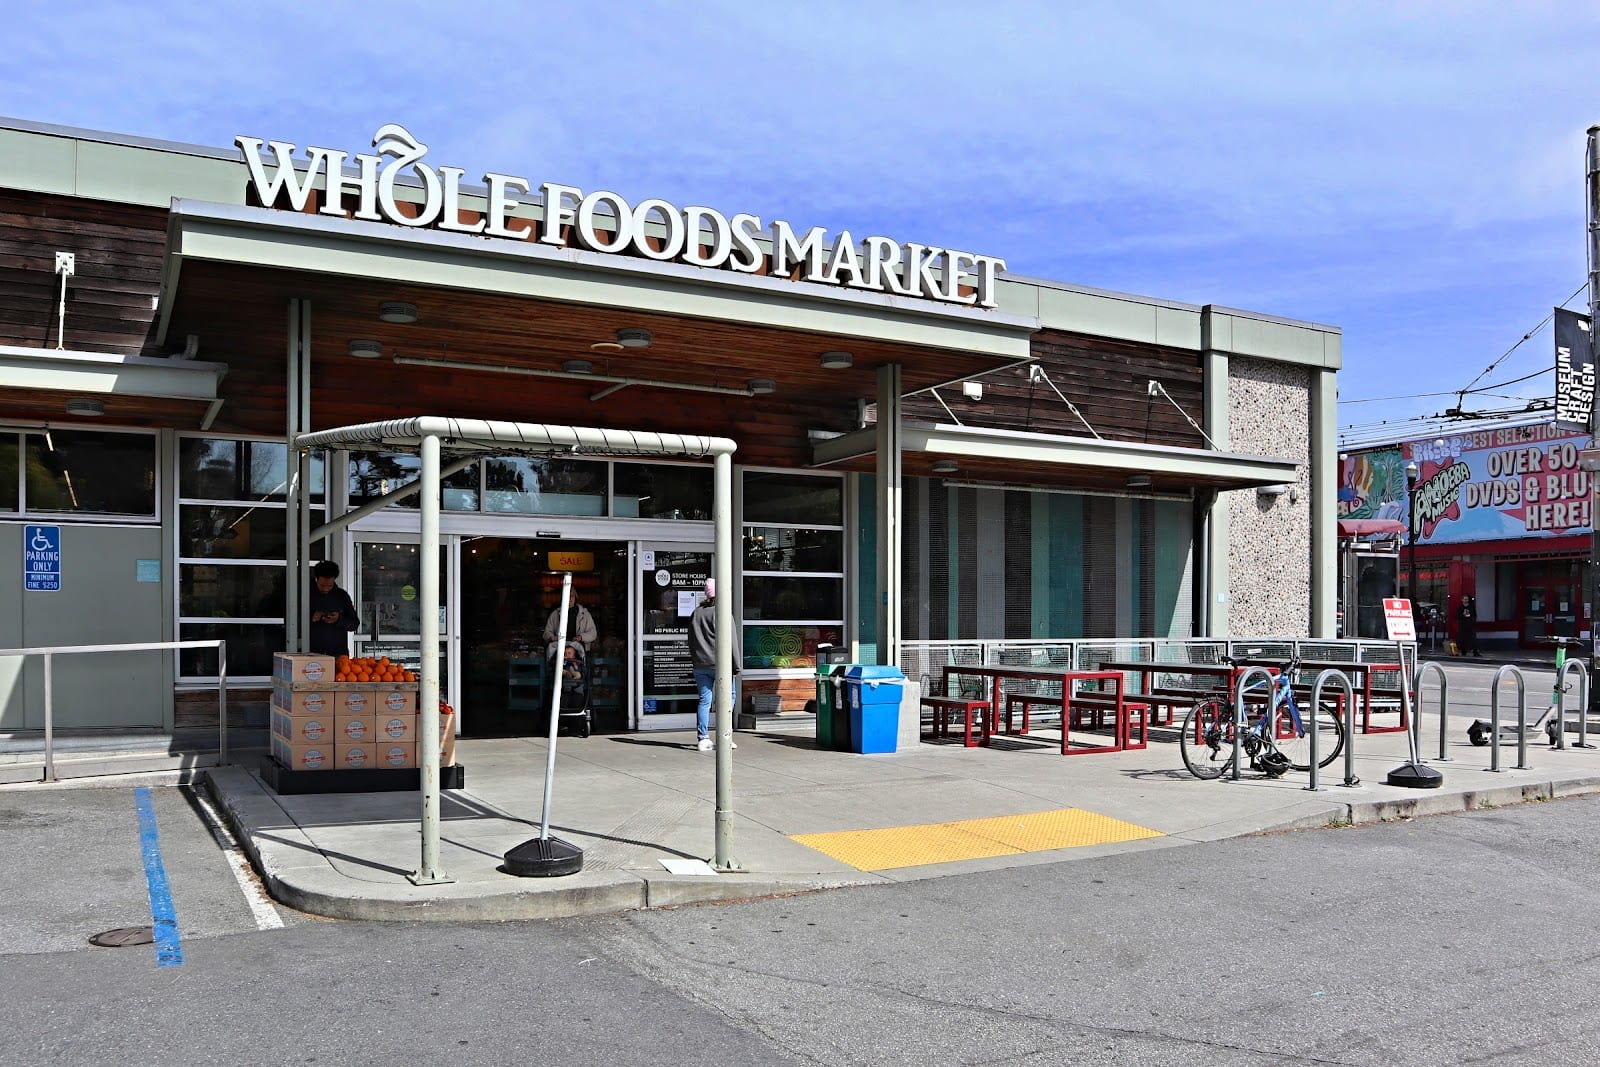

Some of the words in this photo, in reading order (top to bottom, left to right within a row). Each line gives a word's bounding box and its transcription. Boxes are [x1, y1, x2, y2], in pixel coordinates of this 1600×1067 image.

[234, 123, 532, 240] WHOLE
[540, 182, 763, 274] FOODS
[769, 219, 1008, 309] MARKET
[1557, 346, 1571, 421] MUSEUM
[1567, 367, 1583, 423] CRAFT
[1577, 363, 1595, 424] DESIGN
[1487, 446, 1544, 478] OVER
[1413, 461, 1471, 535] AMOEBA
[1431, 486, 1460, 523] MUSIC
[1466, 478, 1521, 509] DVDS
[1525, 476, 1540, 503] &
[1525, 501, 1591, 531] HERE!
[26, 551, 59, 561] PARKING
[33, 561, 53, 571] ONLY
[559, 556, 585, 566] SALE
[27, 581, 41, 589] FINE
[42, 581, 58, 589] $250
